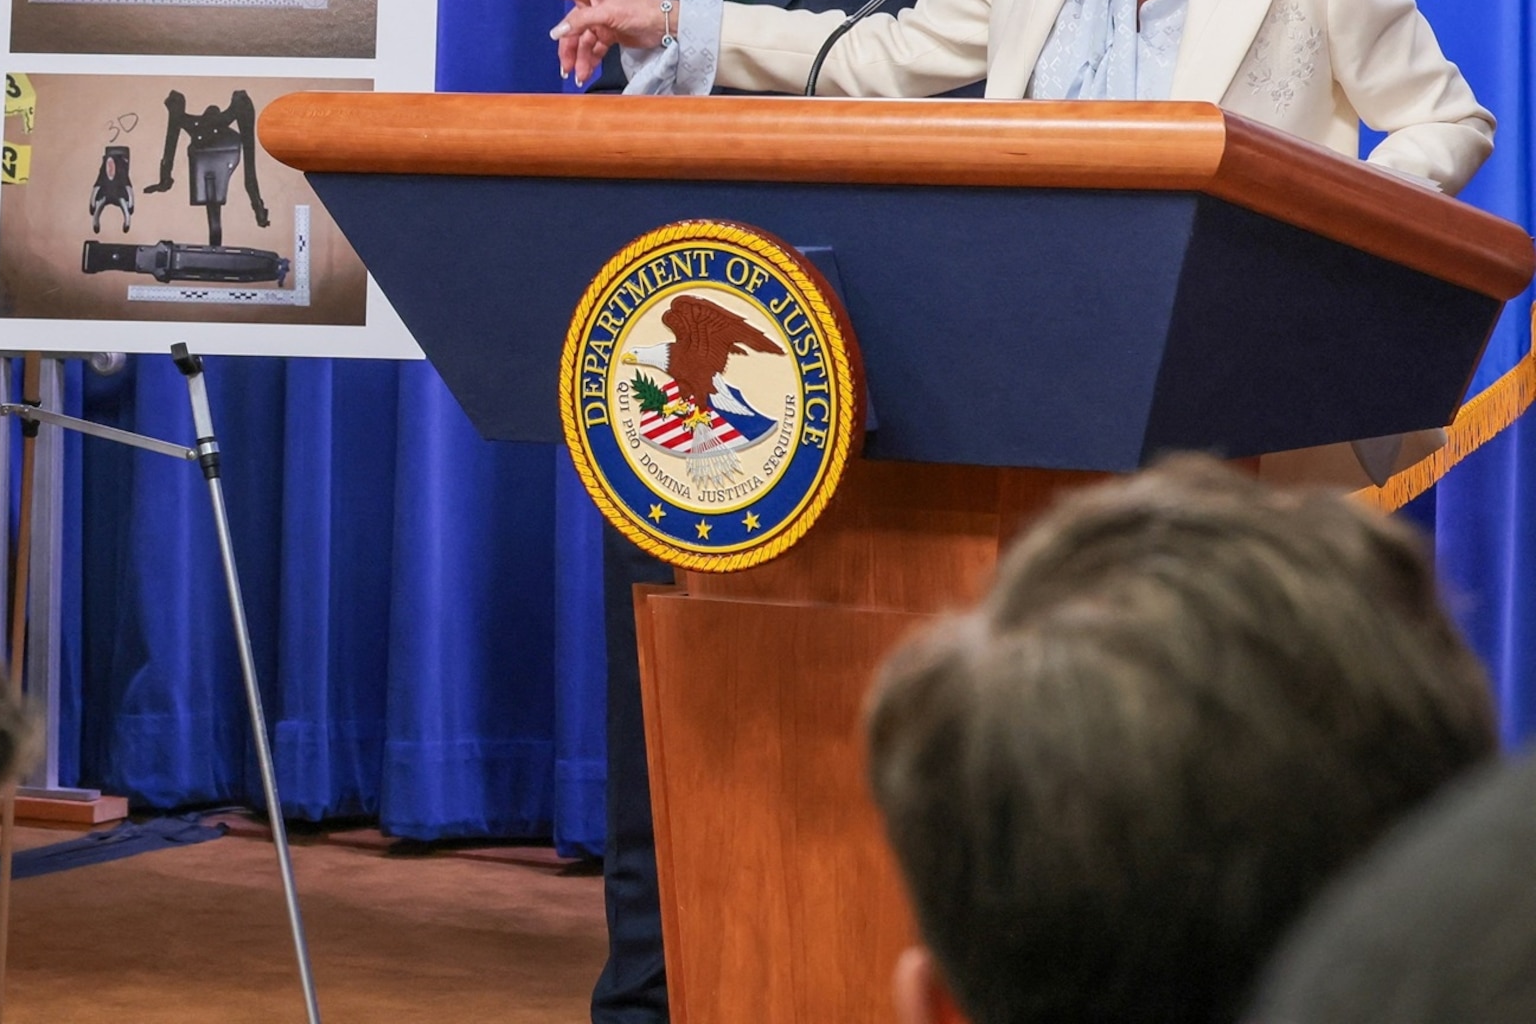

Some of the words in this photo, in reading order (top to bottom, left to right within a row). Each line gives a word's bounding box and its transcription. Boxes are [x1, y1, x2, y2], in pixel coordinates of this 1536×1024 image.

[582, 249, 715, 429] DEPARTMENT
[725, 256, 769, 294] OF
[769, 292, 830, 450] JUSTICE
[616, 381, 630, 413] QUI
[622, 418, 641, 450] PRO
[763, 394, 797, 477] SEQUITUR
[639, 453, 692, 500] DOMINA
[697, 475, 765, 503] JUSTITIA
